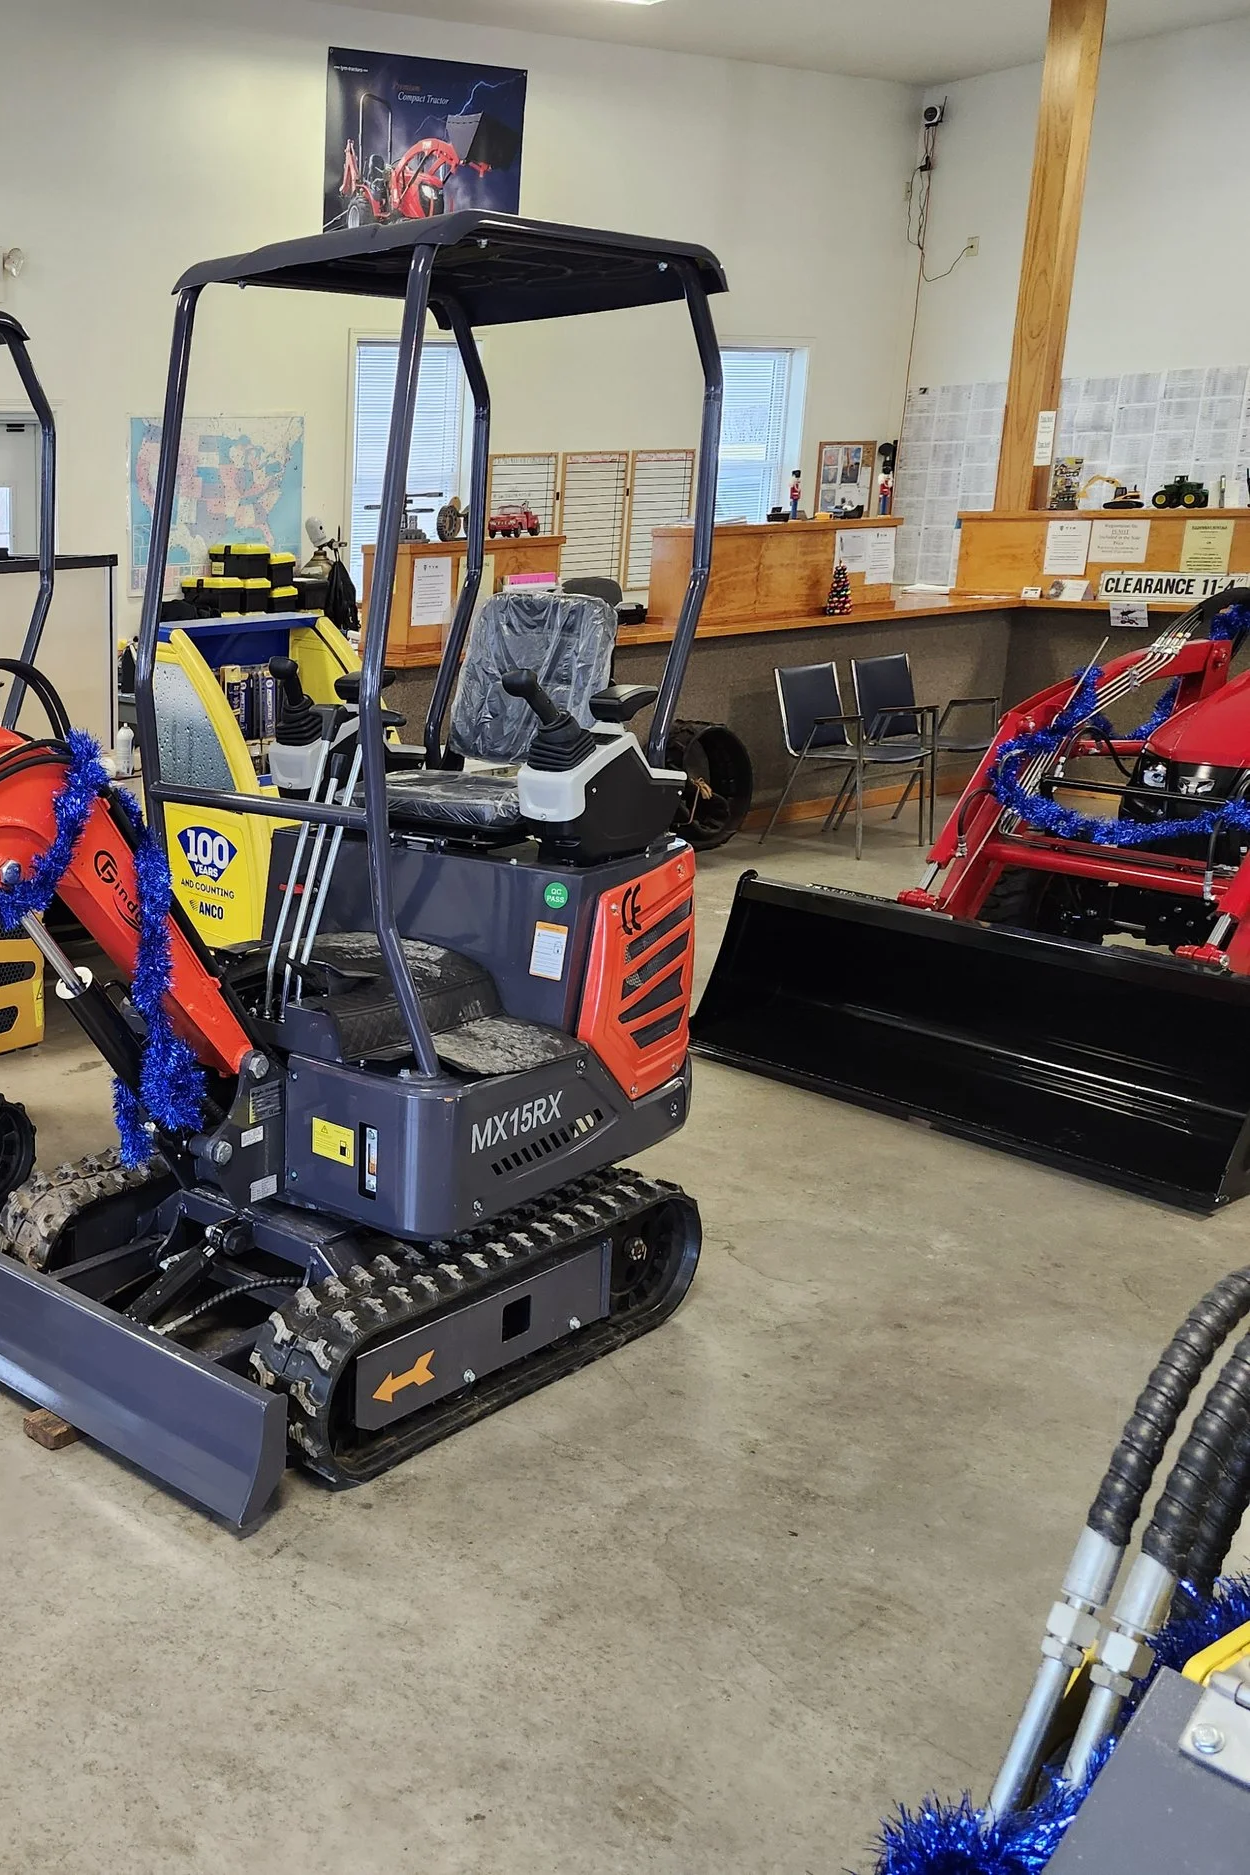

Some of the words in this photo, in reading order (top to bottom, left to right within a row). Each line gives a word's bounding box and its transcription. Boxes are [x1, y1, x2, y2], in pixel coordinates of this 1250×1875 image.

[397, 91, 425, 104] Compact
[426, 94, 450, 105] Tractor
[1104, 577, 1196, 595] CLEARANCE
[186, 829, 229, 870] 100
[194, 863, 218, 878] YEARS
[181, 878, 194, 888] AND
[195, 882, 235, 899] COUNTING
[551, 888, 562, 896] QC
[546, 895, 565, 903] PASS
[198, 901, 224, 920] ANCO
[471, 1090, 563, 1154] MX15RX
